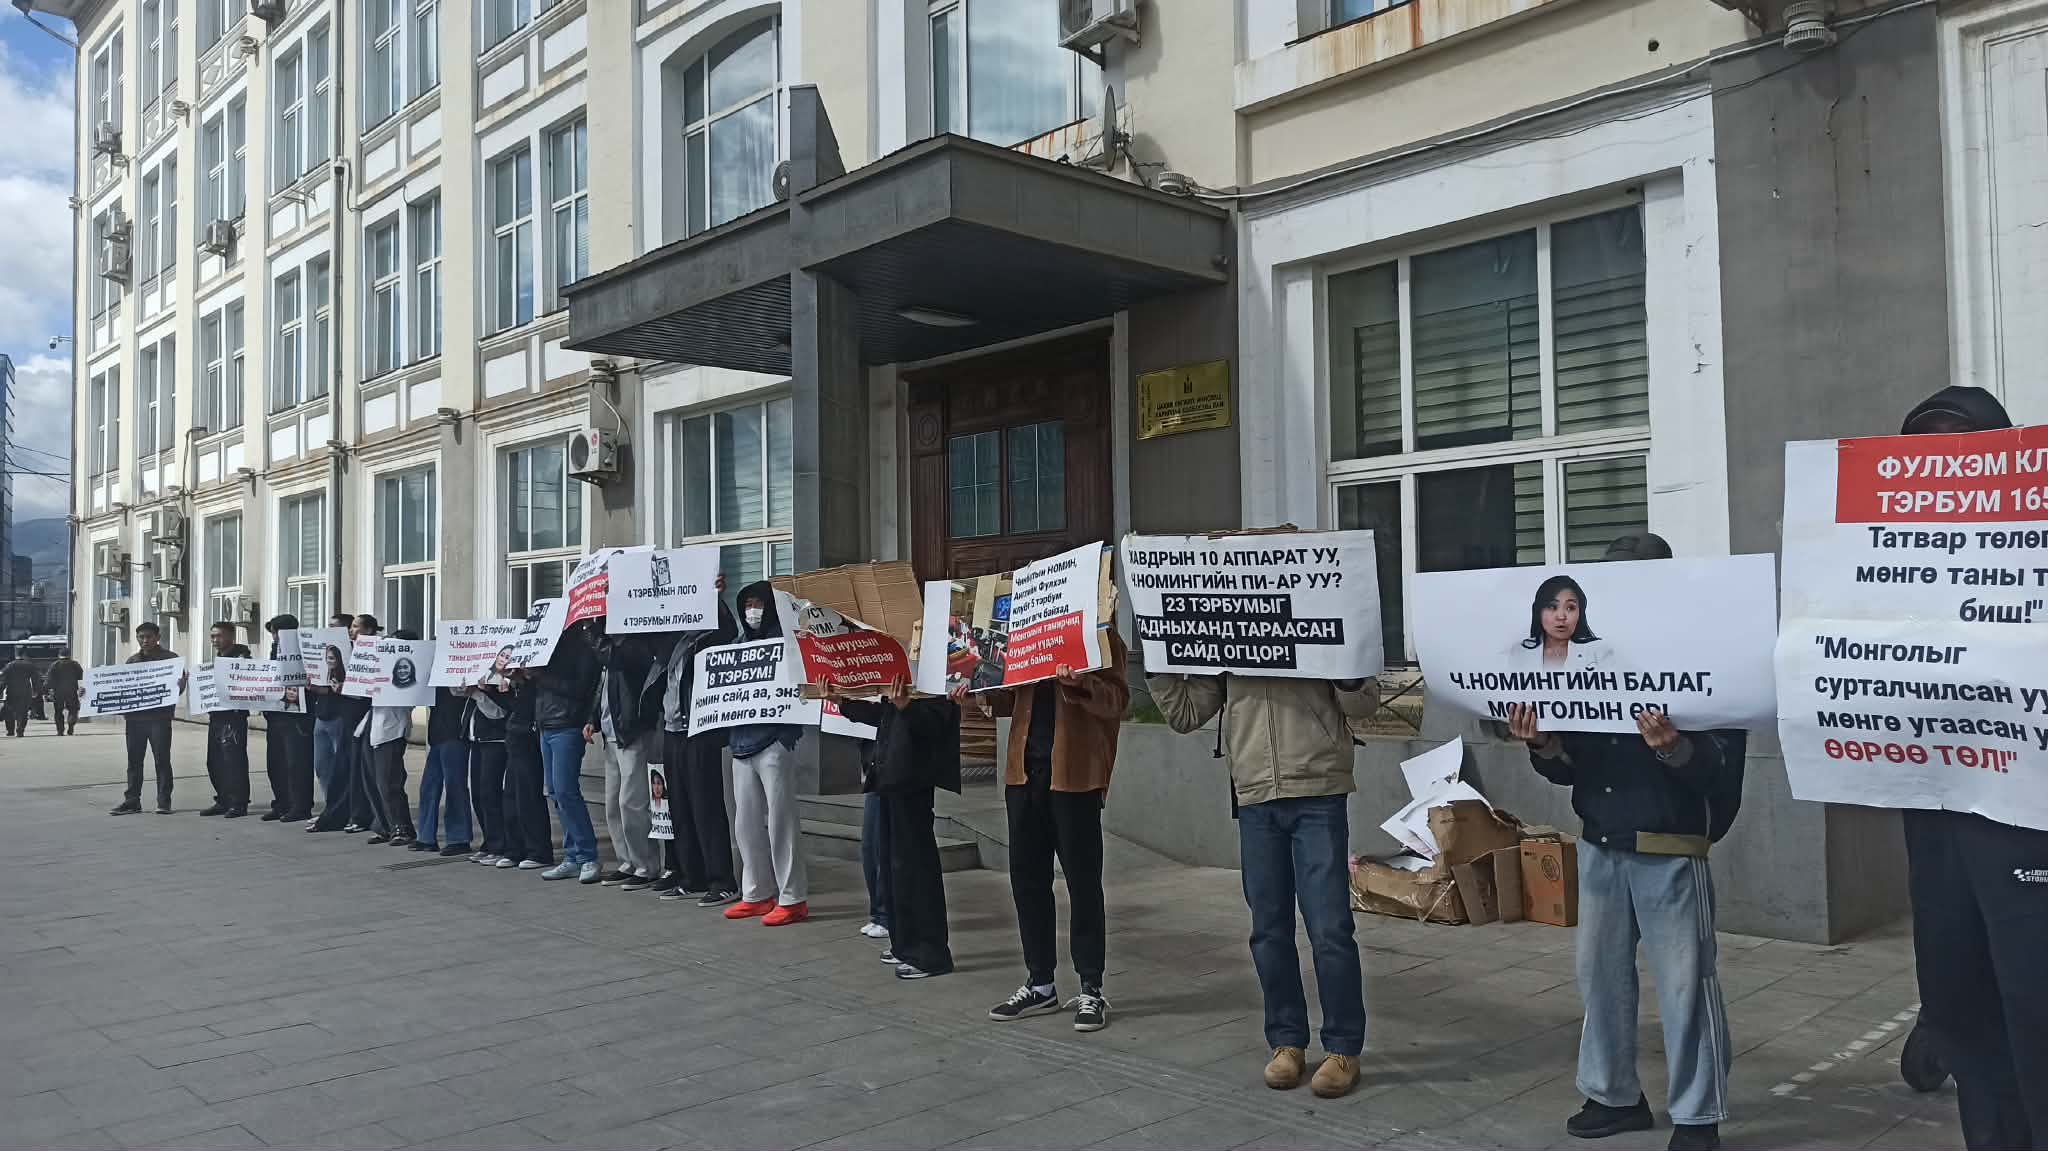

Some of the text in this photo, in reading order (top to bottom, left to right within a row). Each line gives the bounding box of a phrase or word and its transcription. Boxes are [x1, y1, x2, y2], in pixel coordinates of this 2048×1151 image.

[1877, 452, 2008, 479] ФУЛХЭМ
[1877, 489, 2001, 514] ТЭРБУМ
[1869, 526, 1967, 554] Татвар
[1200, 550, 1219, 566] 10
[1223, 549, 1308, 567] АППАРАТ
[1312, 547, 1341, 567] УУ,
[1038, 576, 1067, 592] Фулхэм
[1241, 573, 1302, 590] ПИ-АР
[1306, 571, 1343, 589] УУ?
[1856, 566, 1938, 584] мөнгө
[1947, 567, 2025, 587] таны
[628, 584, 698, 599] 4 ТЭРБУМЫН ЛОГО
[1036, 591, 1062, 608] тэрбум
[1043, 603, 1069, 620] байхад
[1166, 597, 1286, 614] 23 ТЭРБУМЫГ
[1959, 597, 2043, 624] биш!"
[624, 612, 704, 628] 4 ТЭРБУМЫН ЛУЙВАР
[1237, 621, 1336, 638] ТАРААСАН
[1030, 651, 1053, 665] байна
[1171, 640, 1290, 664] САЙД ОГЦОР!
[1816, 635, 1968, 664] "Монголыг
[709, 666, 772, 686] 8 ТЭРБУМ!
[1450, 667, 1713, 696] Ч.НОМИНГИЙН БАЛАГ,
[722, 688, 750, 703] сайд
[753, 688, 771, 700] аа,
[1815, 675, 2014, 704] сурталчилсан
[721, 709, 757, 722] мөнгө
[760, 704, 791, 719] вэ?"
[1817, 711, 1901, 731] мөнгө
[1907, 716, 2028, 742] угаасан
[1824, 738, 2018, 773] ӨӨРӨӨ ТӨЛ!"
